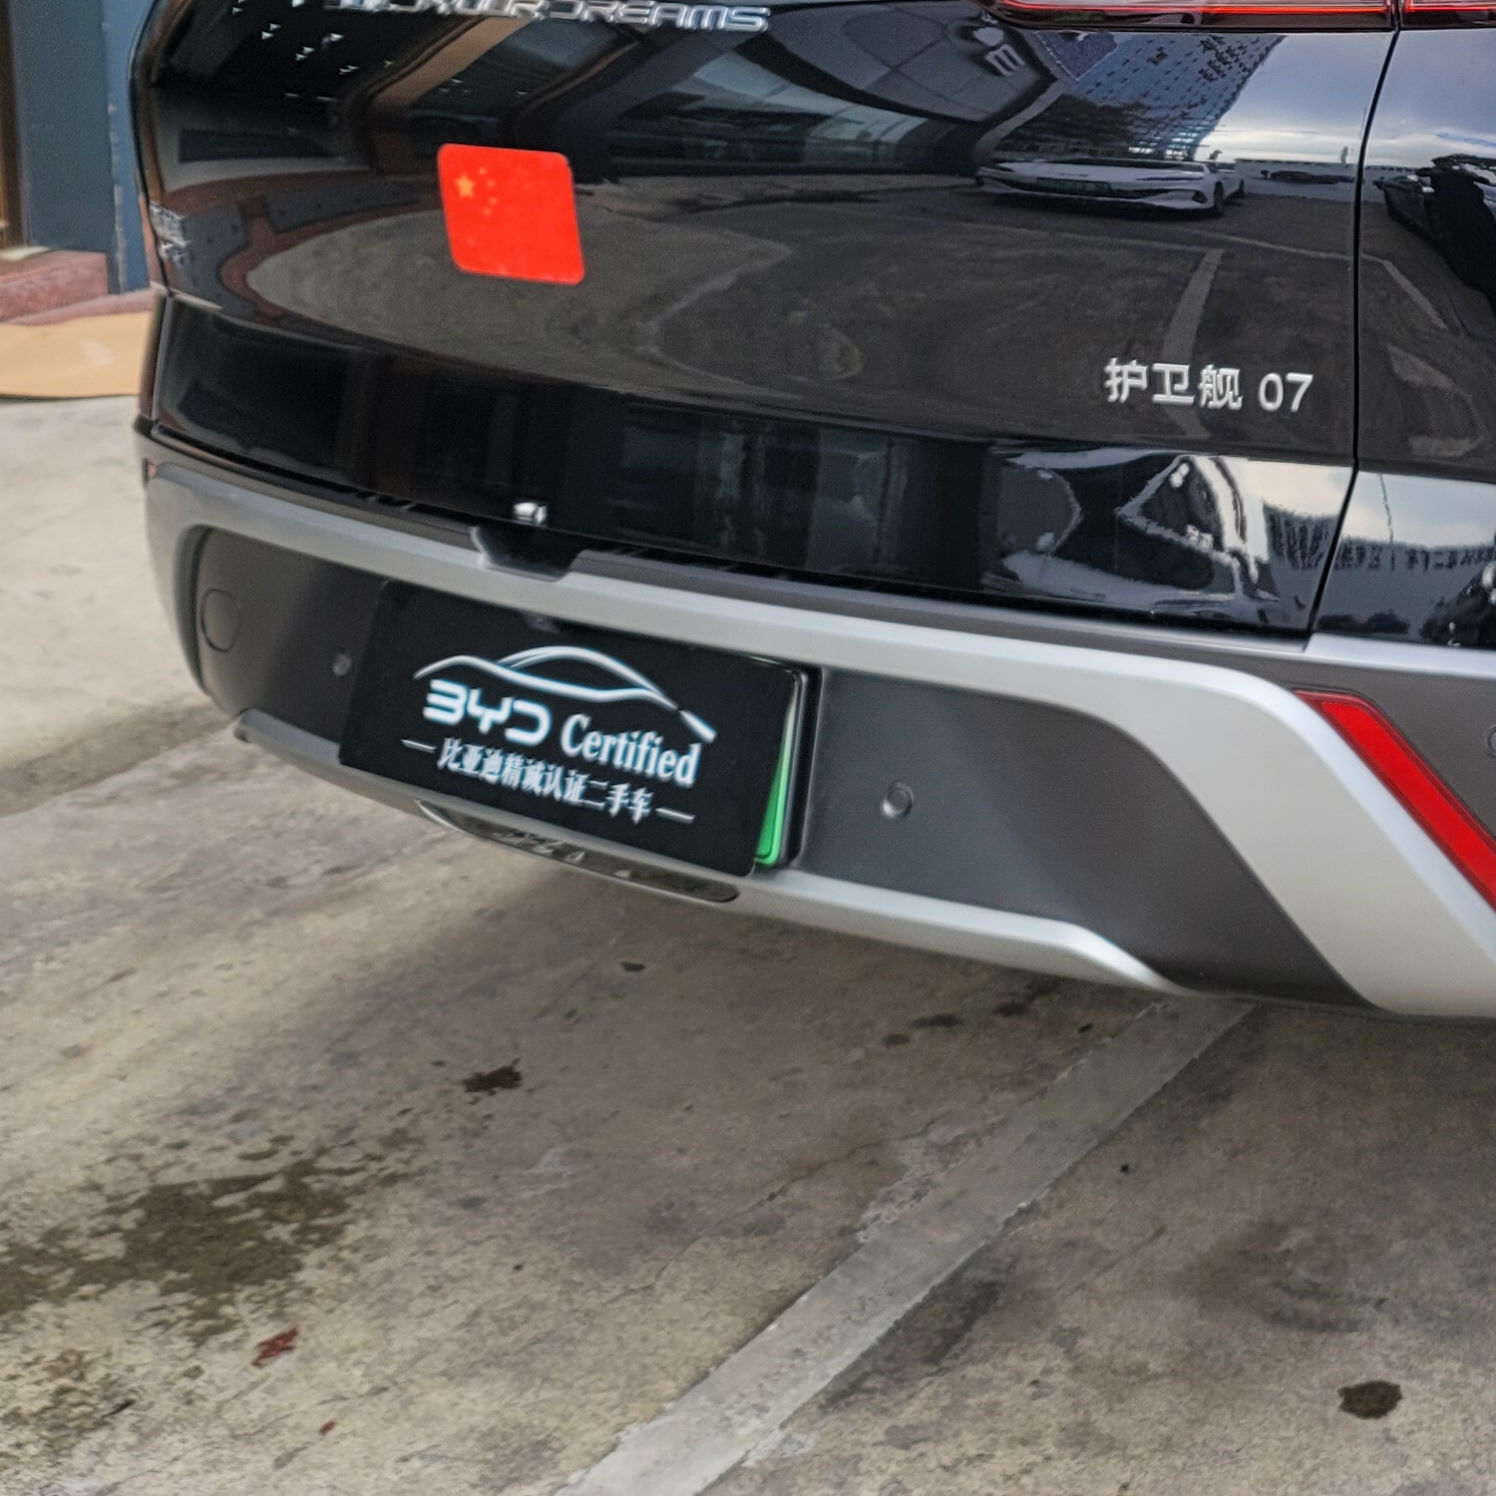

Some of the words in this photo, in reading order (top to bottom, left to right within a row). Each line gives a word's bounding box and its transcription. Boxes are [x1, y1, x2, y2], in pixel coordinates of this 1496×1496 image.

[1103, 357, 1244, 410] 护卫舰
[1258, 372, 1314, 413] 07
[423, 678, 553, 747] BYD
[560, 713, 701, 788] Certified
[436, 737, 654, 825] 比亚迪精诚认证二手车
